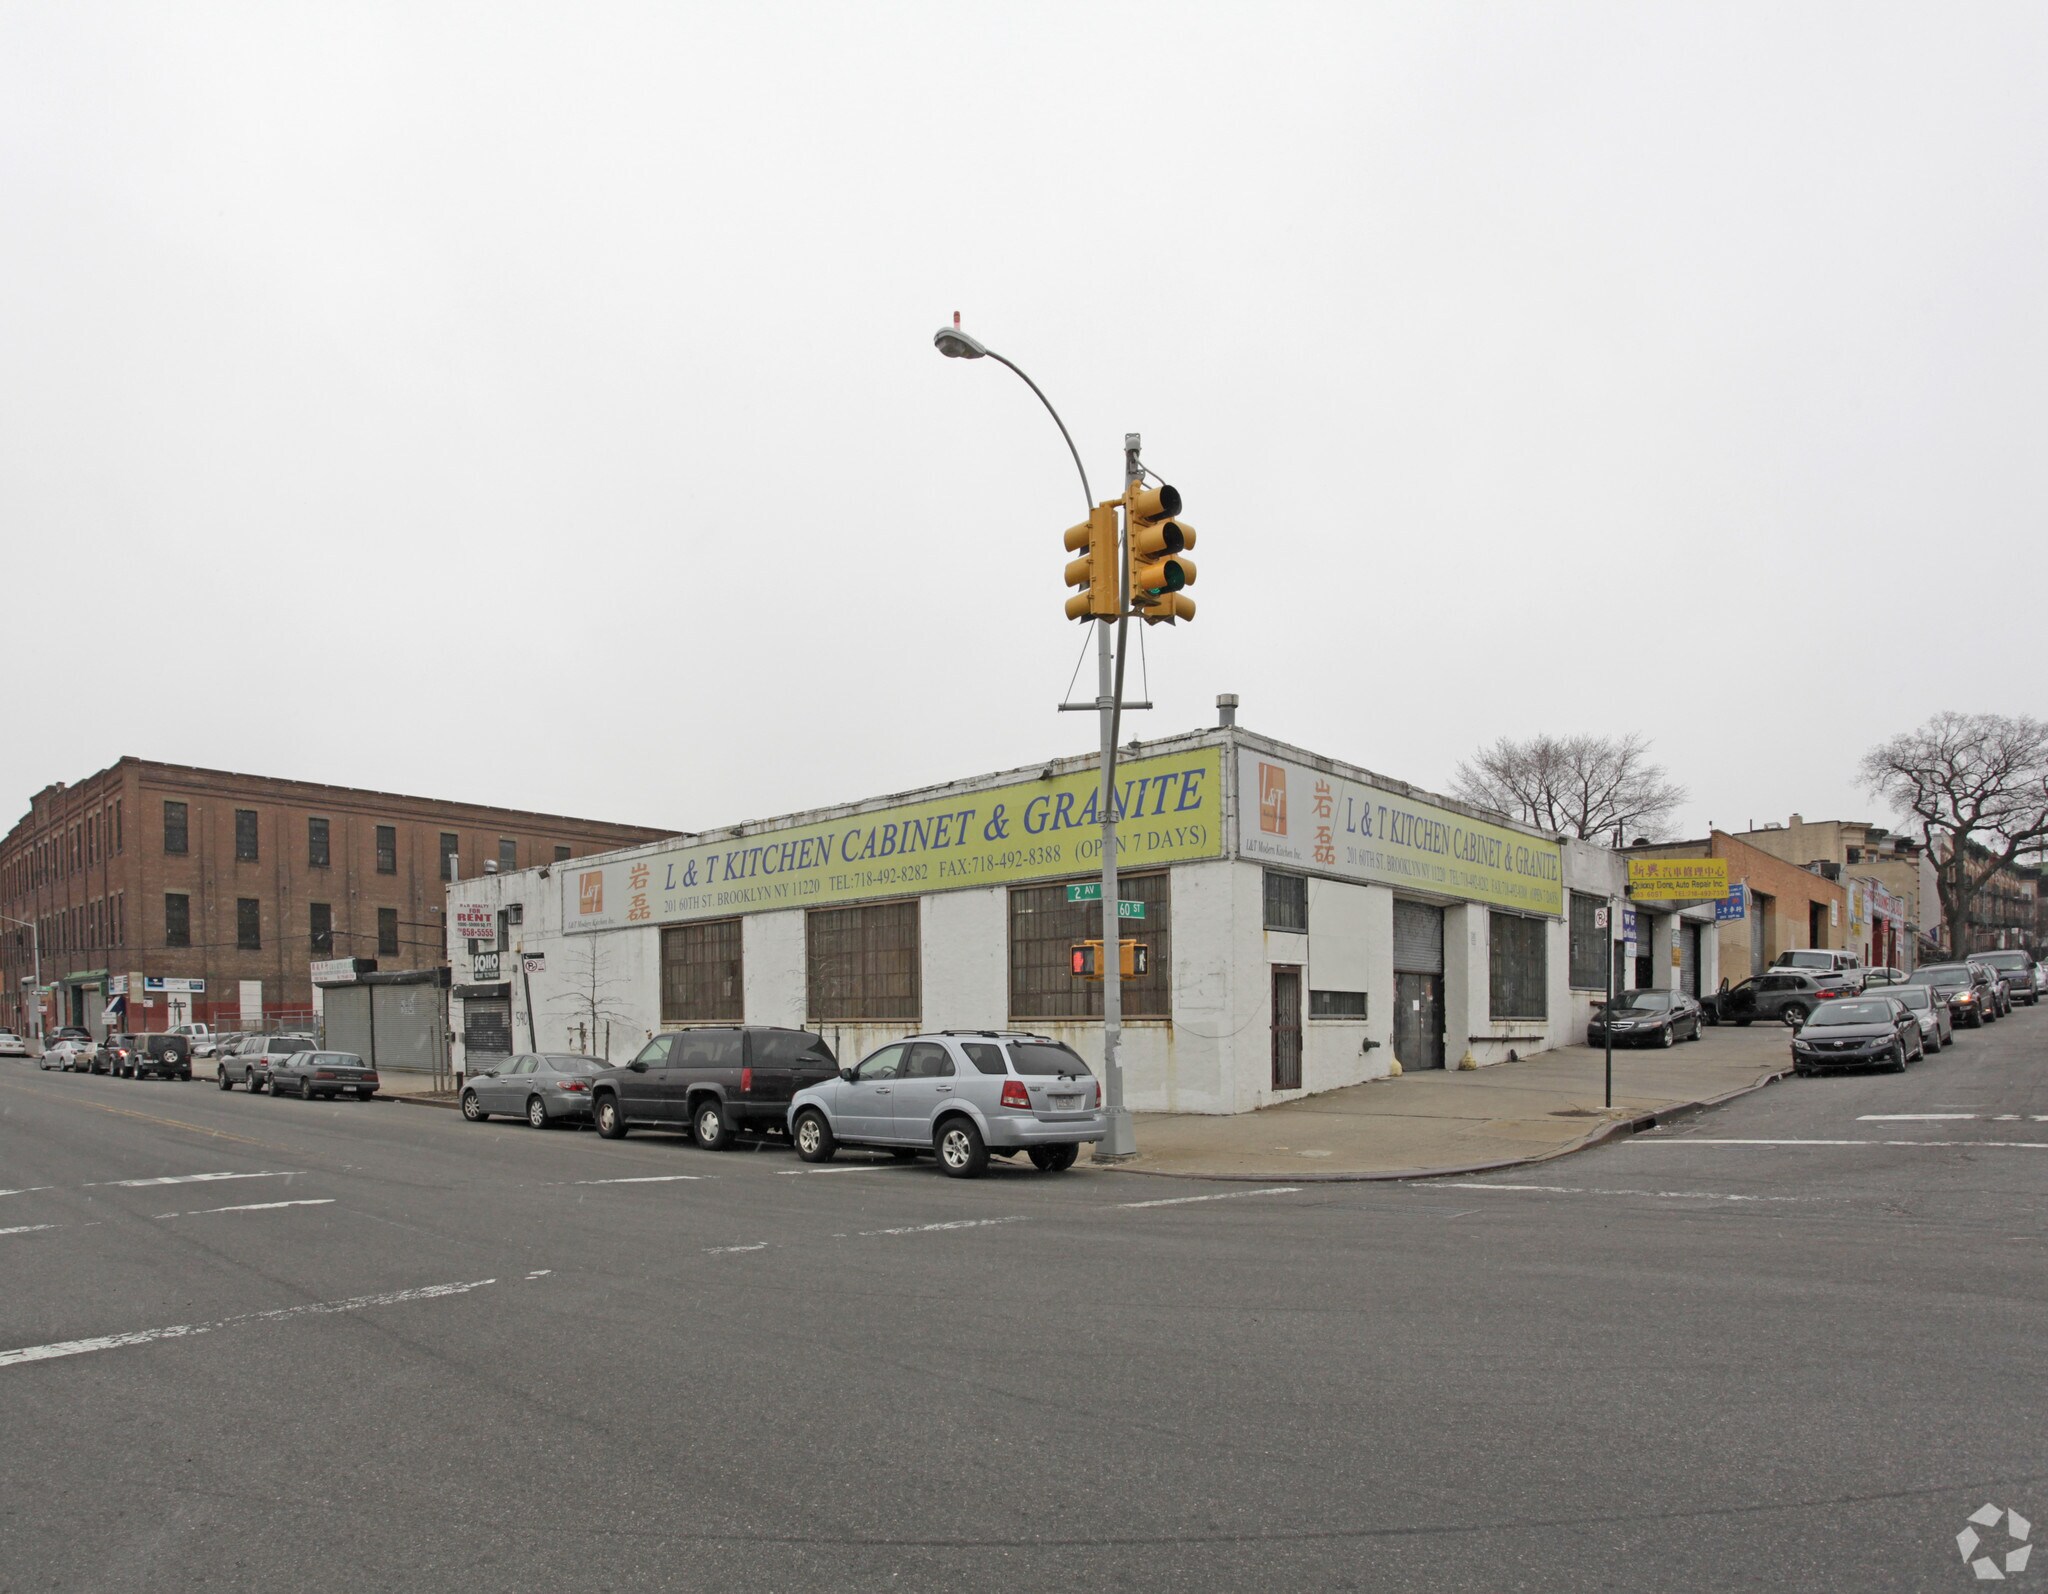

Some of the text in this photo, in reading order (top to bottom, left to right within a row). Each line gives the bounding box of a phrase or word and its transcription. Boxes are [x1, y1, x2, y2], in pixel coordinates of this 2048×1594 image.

[664, 767, 1206, 891] L & T KITCHEN CABINET & GRANITE
[1312, 778, 1335, 865] 岩磊
[1346, 797, 1558, 881] L & T KITCHEN CABINET & GRANITE
[664, 824, 1207, 913] 201 60TH ST. BROOKLYN NY 11220 TEL:718-492-8282 FAX:718-492-8388 (OPN 7 DAYS)
[1346, 846, 1357, 865] 201
[1387, 854, 1421, 876] BROOKLYN
[626, 862, 651, 921] 岩磊
[1074, 885, 1095, 900] 2 AV
[1675, 881, 1690, 889] Auto
[1691, 879, 1712, 889] Repair
[457, 913, 492, 922] RENT
[1119, 903, 1141, 916] 60 ST
[515, 1011, 528, 1027] 590
